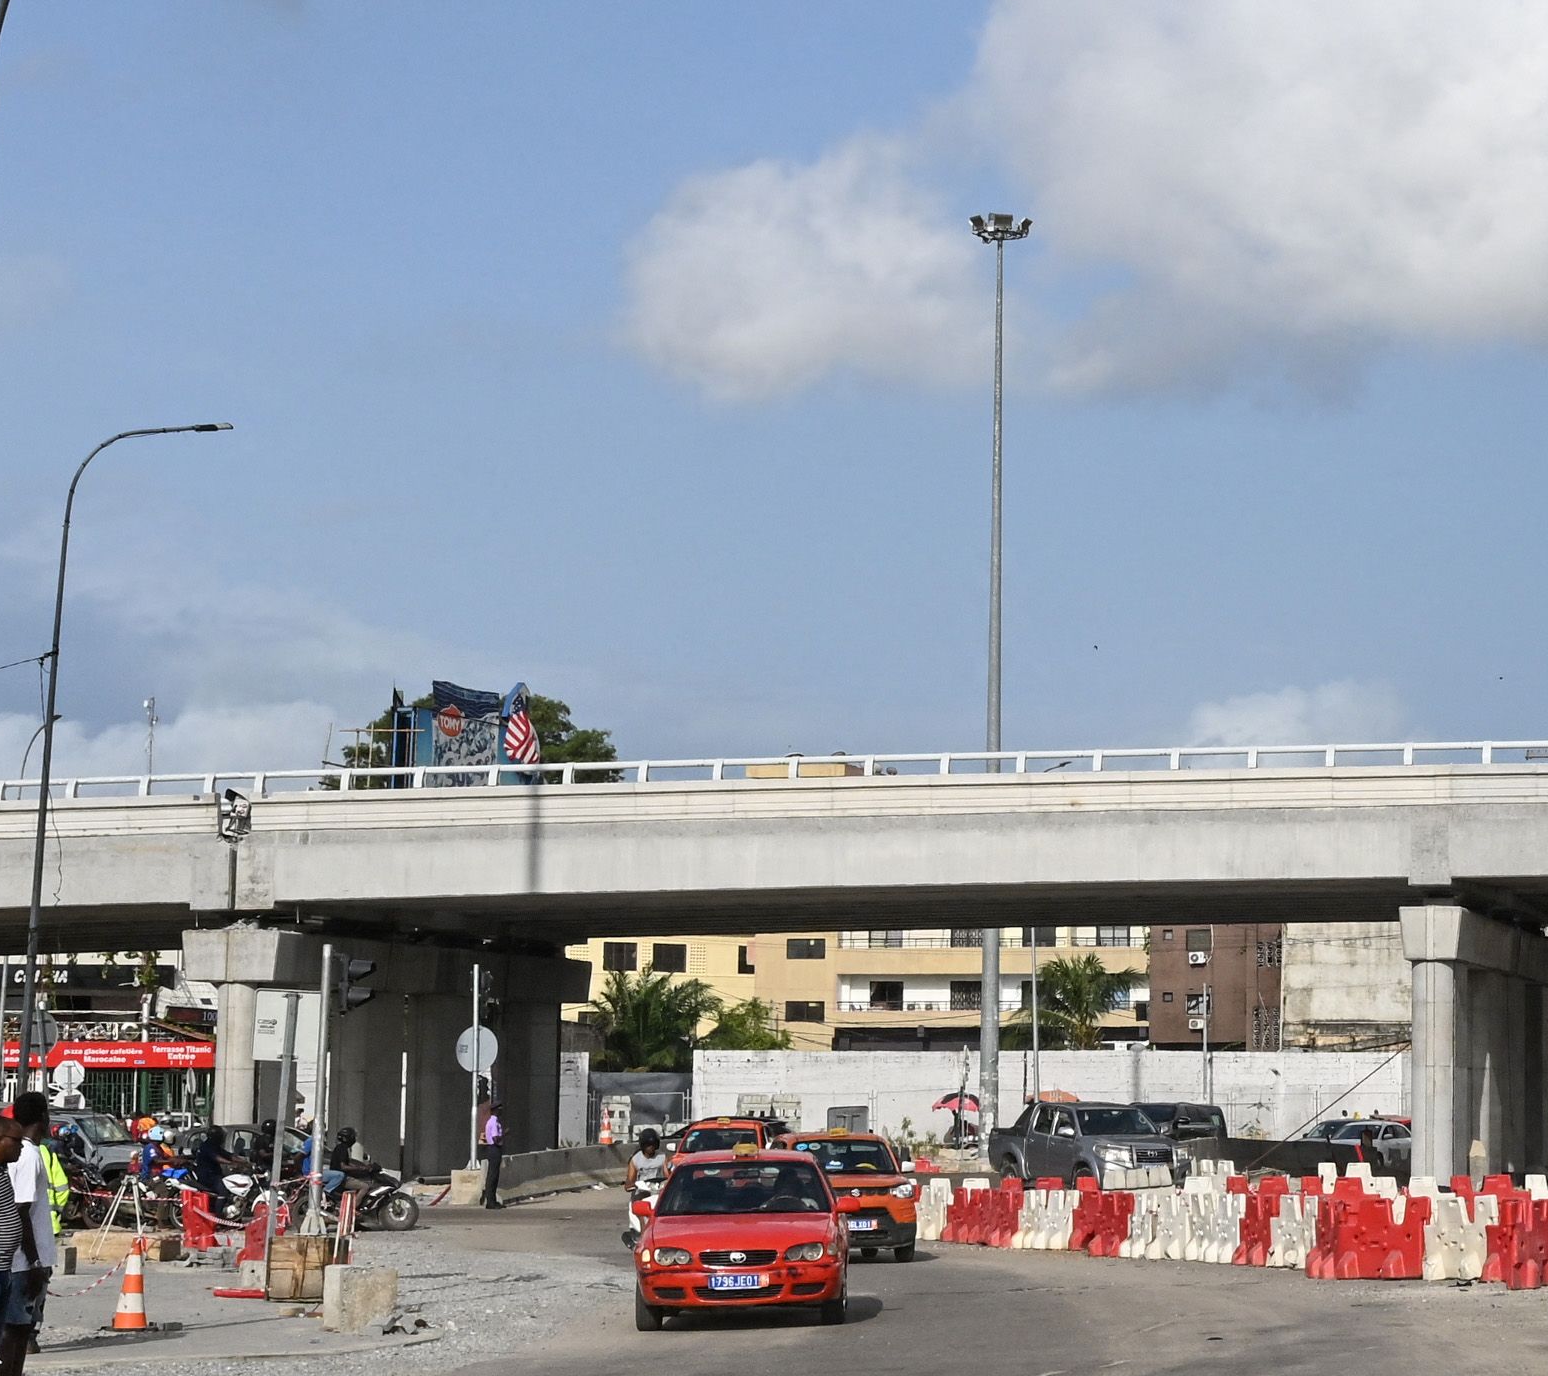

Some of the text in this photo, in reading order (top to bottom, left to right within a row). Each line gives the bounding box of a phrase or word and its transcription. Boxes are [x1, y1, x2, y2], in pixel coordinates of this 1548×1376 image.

[83, 1048, 109, 1056] glacier
[152, 1045, 212, 1054] Terrasse Titanic
